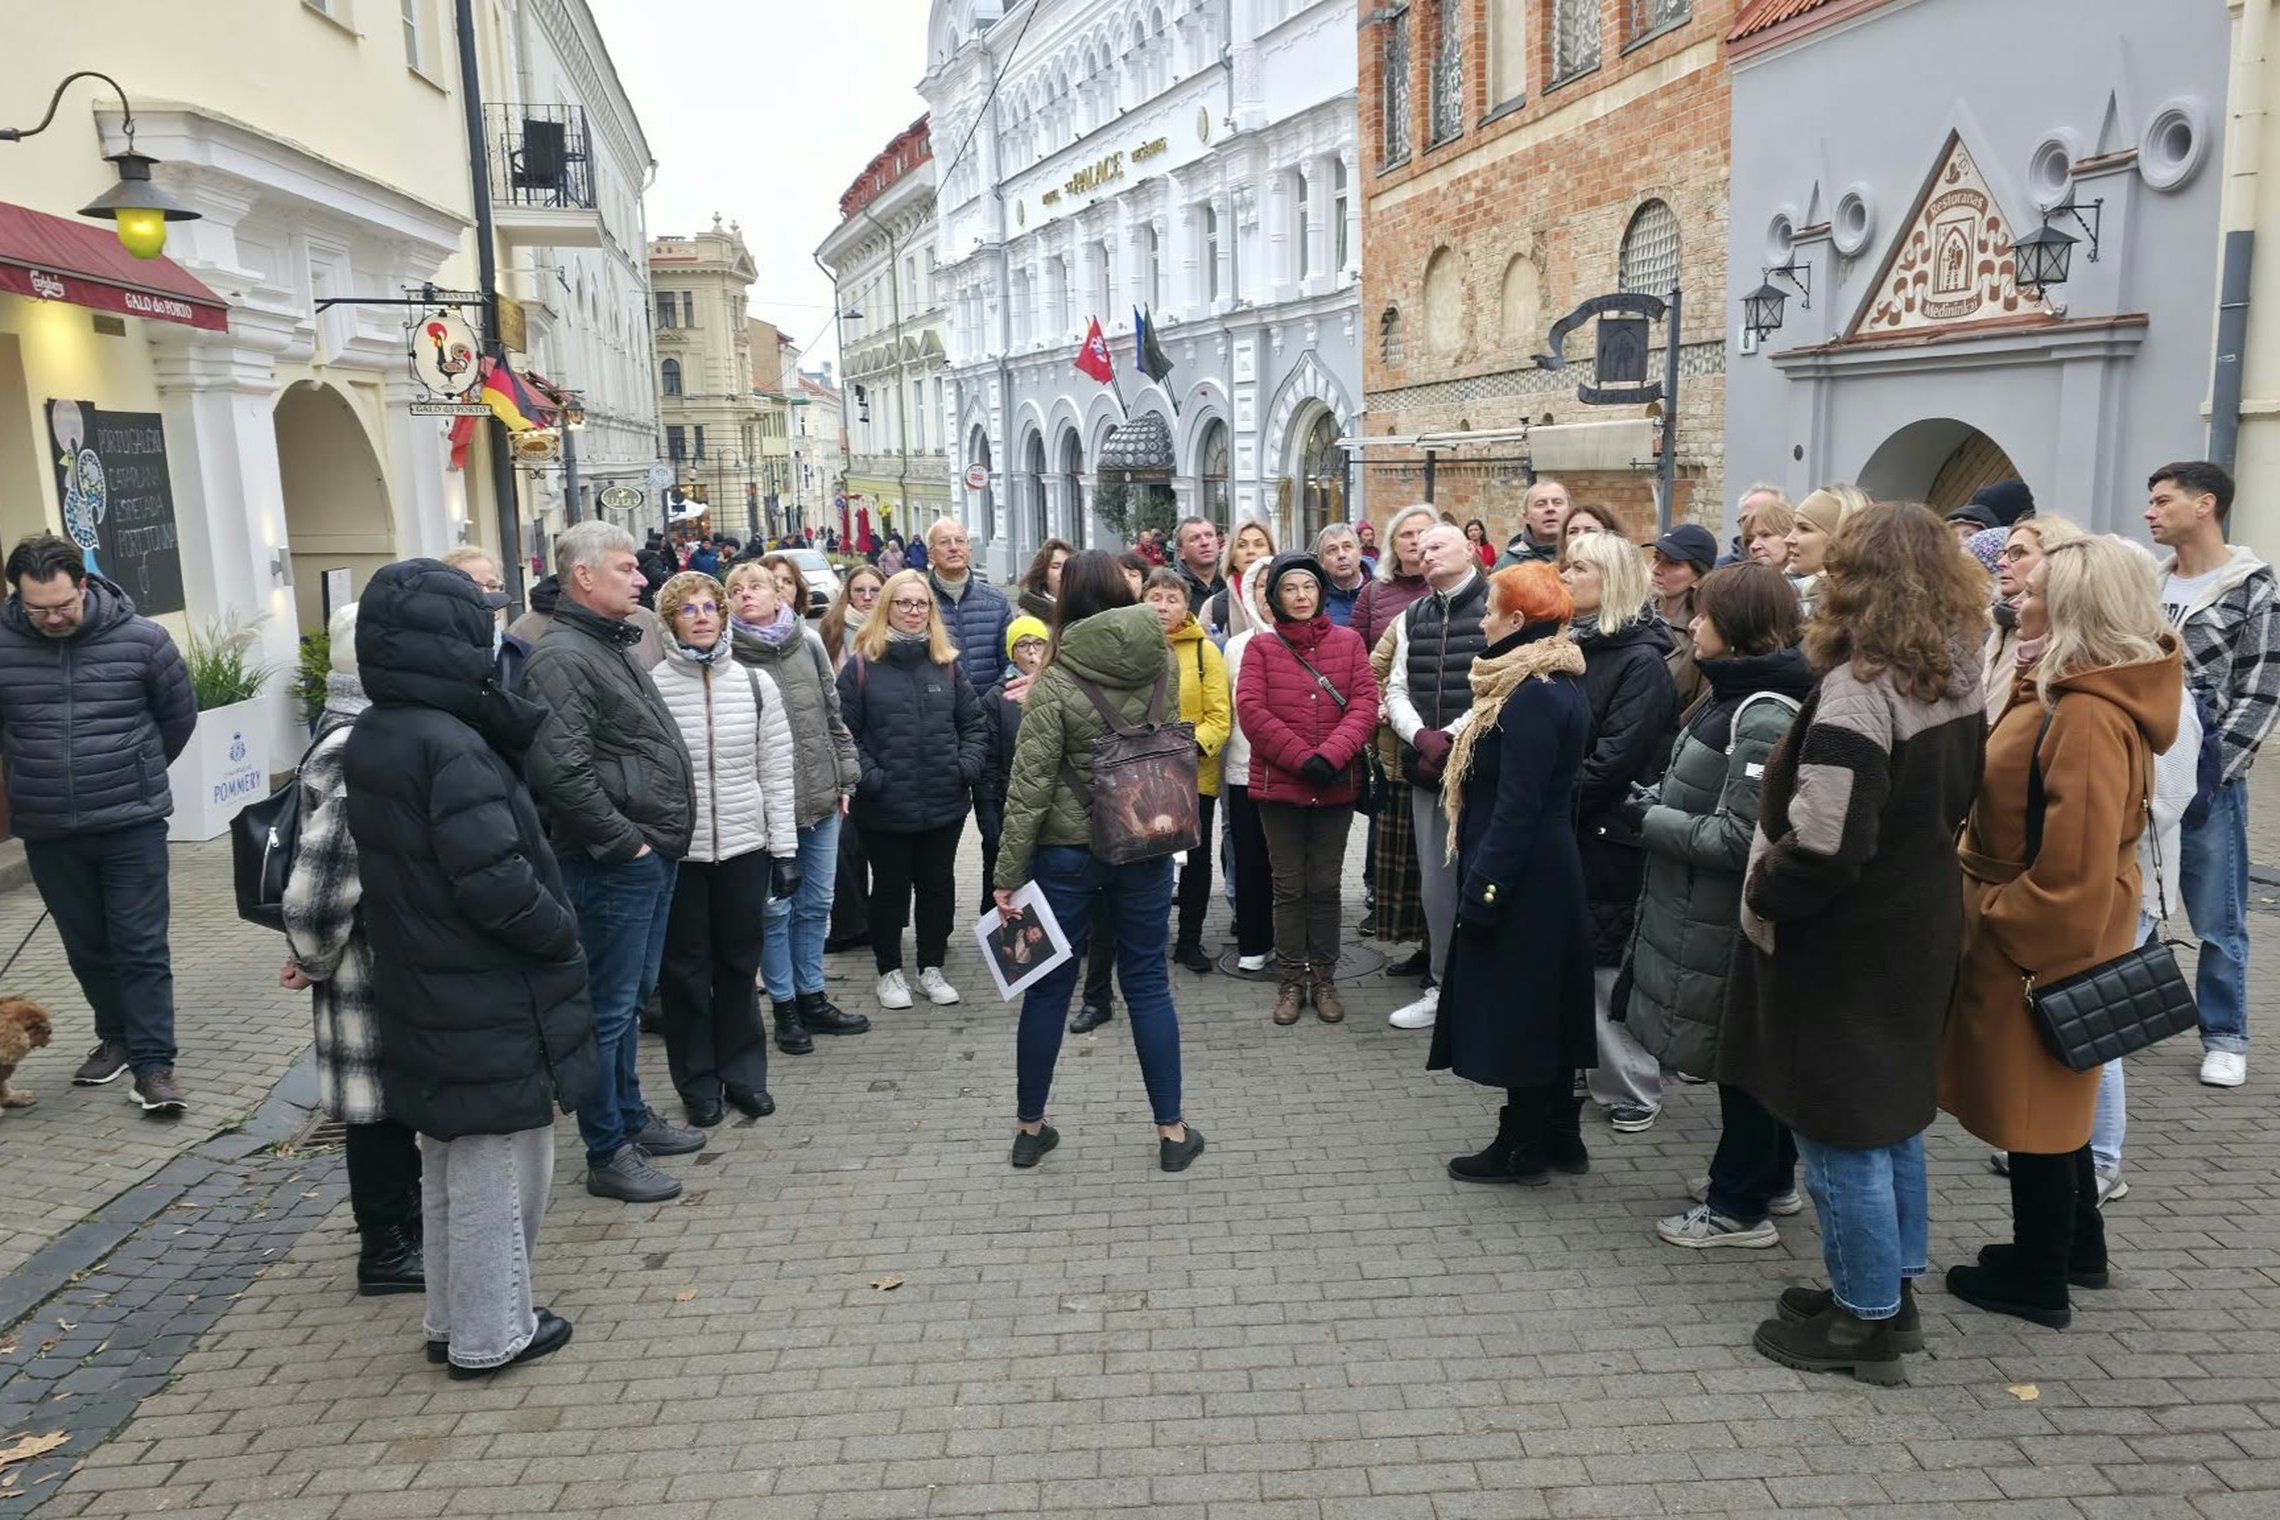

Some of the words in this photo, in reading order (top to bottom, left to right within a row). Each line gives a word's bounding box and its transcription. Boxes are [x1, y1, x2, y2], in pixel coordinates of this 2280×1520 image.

[1073, 151, 1124, 195] PALACE
[1930, 192, 1984, 216] Restoranas
[125, 293, 151, 312] GALO
[153, 298, 165, 314] do
[166, 300, 192, 319] PORTO
[1924, 296, 1978, 317] Medininkai
[214, 771, 260, 804] POMMERY
